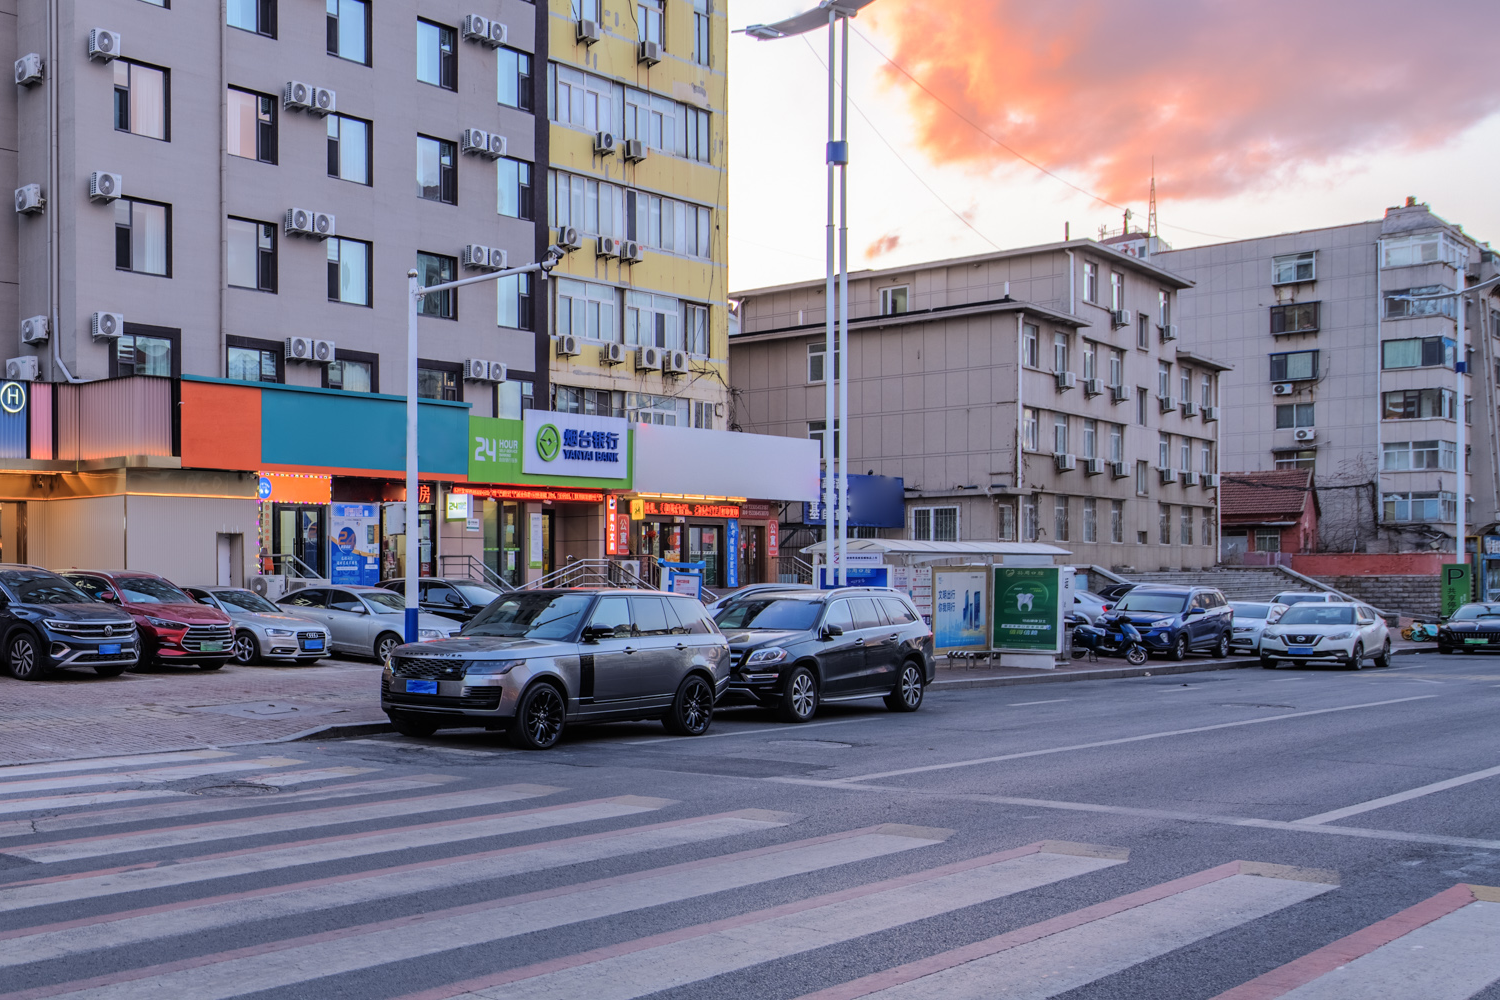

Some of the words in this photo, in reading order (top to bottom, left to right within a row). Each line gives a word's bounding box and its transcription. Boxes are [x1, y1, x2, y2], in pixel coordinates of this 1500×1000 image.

[563, 428, 619, 450] 烟台银行
[474, 436, 497, 462] 24
[499, 439, 518, 450] HOUR
[563, 449, 593, 461] YANTAI
[595, 451, 619, 463] BANK
[419, 485, 430, 503] 房
[449, 502, 458, 510] 24
[620, 518, 627, 545] 公寓
[770, 523, 776, 547] 公寓
[1448, 568, 1464, 585] P
[938, 590, 955, 600] 文明出行
